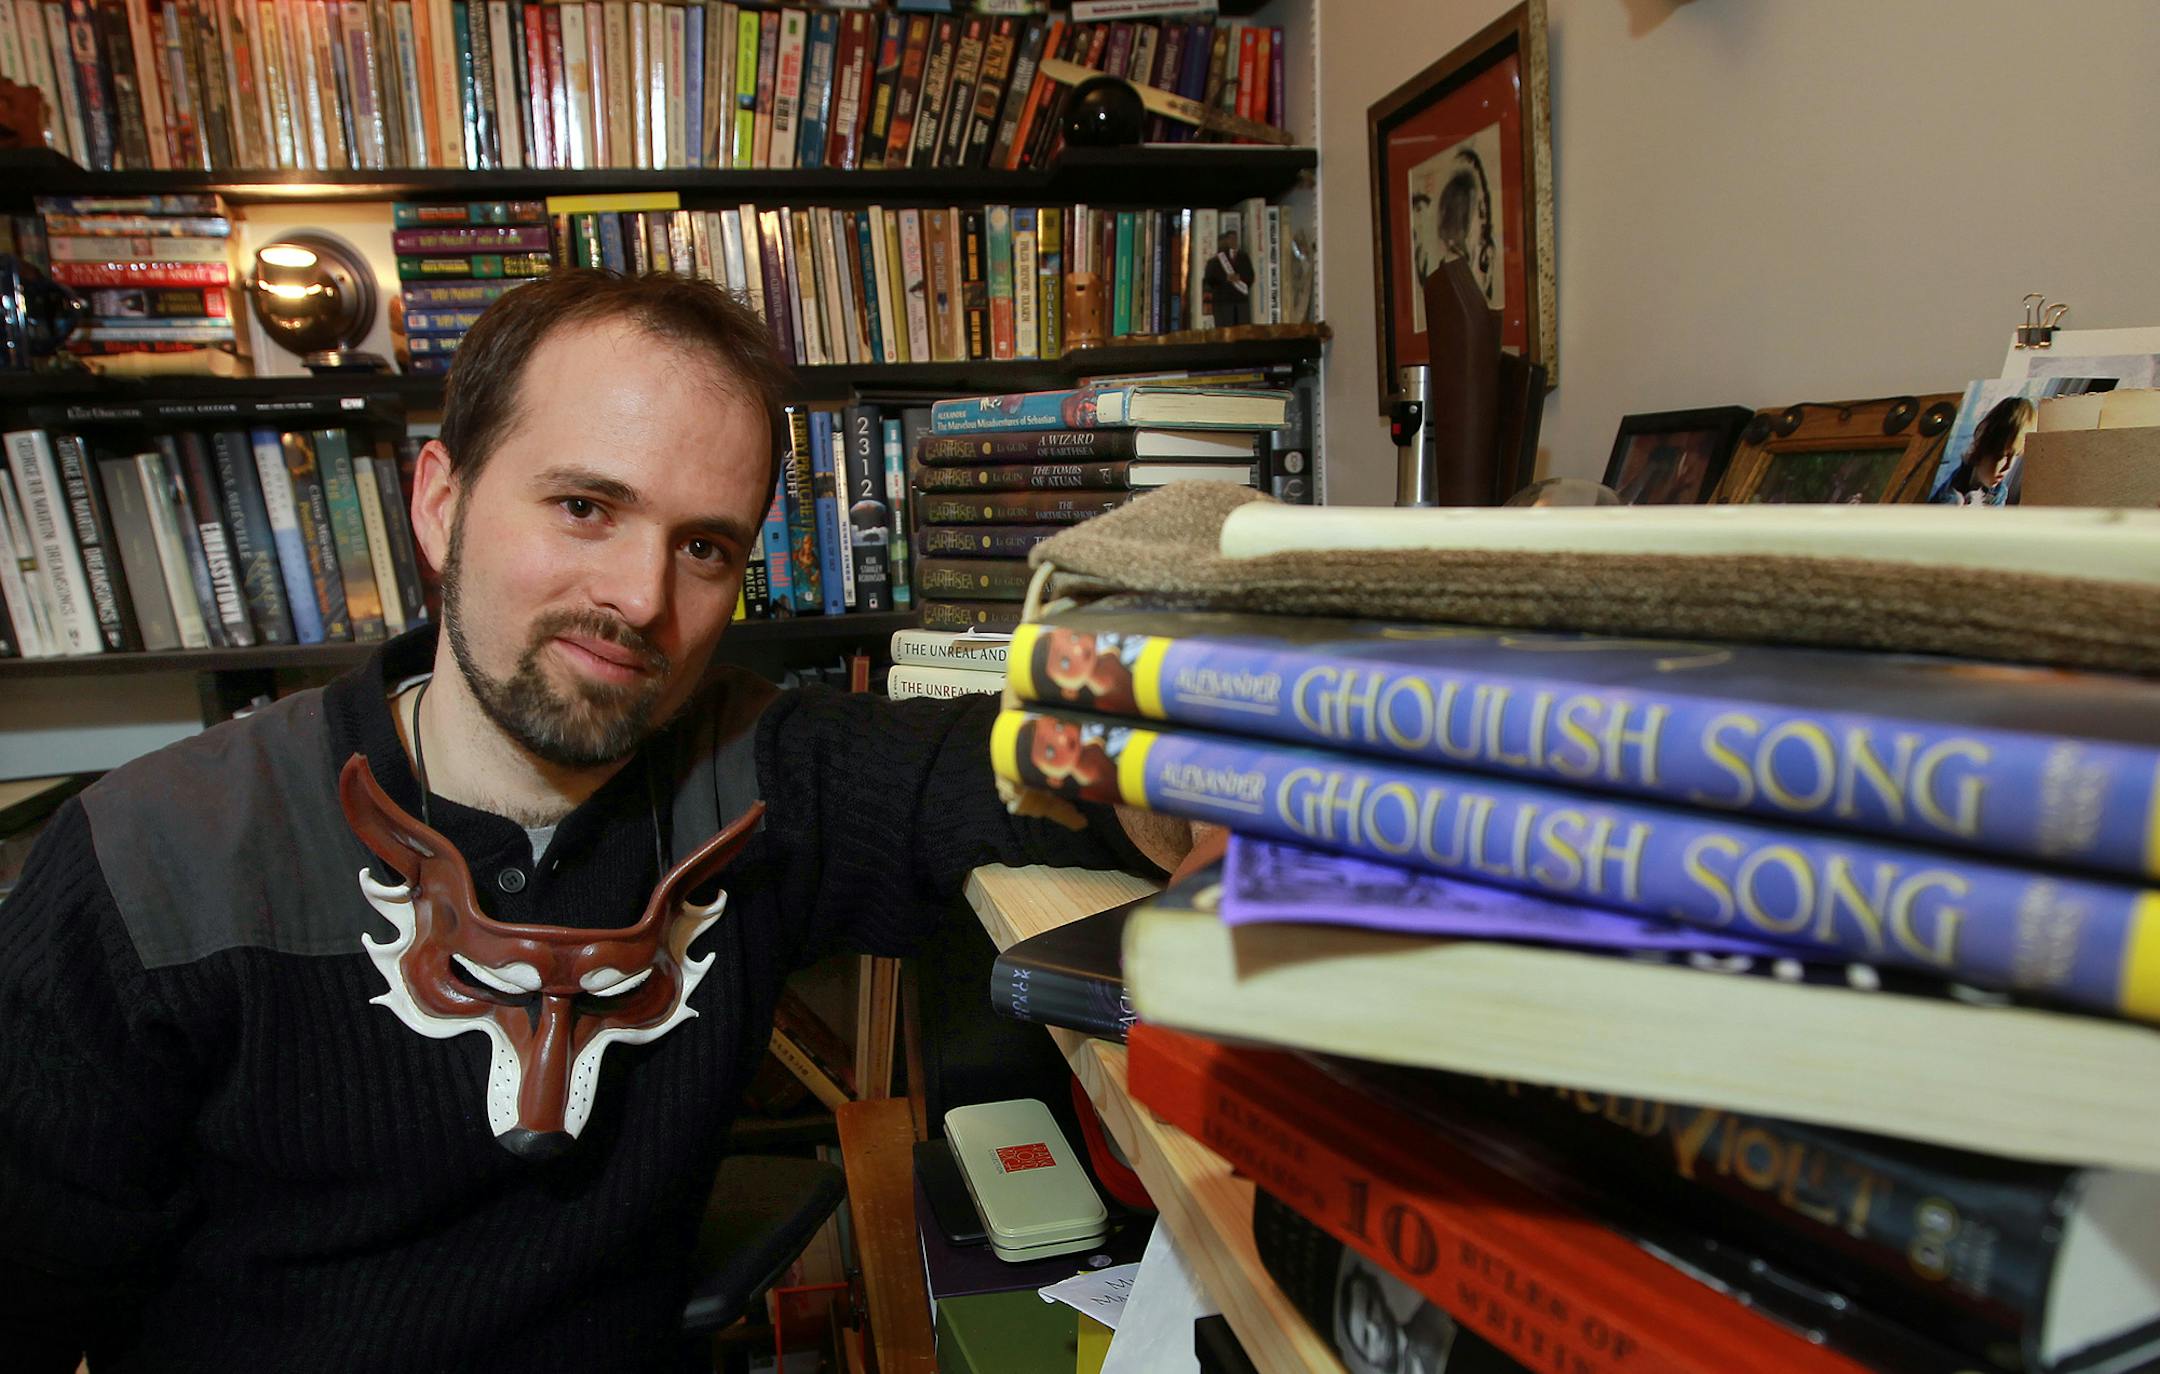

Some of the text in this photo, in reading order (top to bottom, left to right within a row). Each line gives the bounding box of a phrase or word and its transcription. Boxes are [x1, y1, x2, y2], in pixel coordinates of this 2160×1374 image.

[937, 410, 967, 420] ALEXANDER
[937, 415, 1057, 430] The Marvelous Misadventures of Sebastian
[1005, 442, 1028, 452] GUIN
[1038, 433, 1095, 446] A WIZARD
[213, 432, 235, 487] CHINA
[1037, 447, 1095, 457] OF EARTHSEA
[783, 450, 800, 499] SNUFF
[792, 413, 816, 533] TERRY PRATCHETT
[1001, 473, 1024, 482] GUIN
[1032, 465, 1083, 475] THE TOMBS
[1031, 475, 1083, 487] OF ATUAN
[1058, 501, 1074, 510] THE
[1005, 537, 1026, 546] GUIN
[199, 522, 244, 625] EMBASSYTOWN
[859, 564, 883, 574] STANLEY
[755, 566, 768, 599] NIGHT
[858, 572, 886, 583] ROBINSON
[922, 568, 975, 590] EARTHSEA
[1004, 577, 1026, 586] GUIN
[923, 605, 973, 625] EARTHSEA
[904, 642, 1007, 662] THE UNREAL AND
[901, 680, 923, 695] THE
[1173, 666, 1282, 704] ALEXANDER
[1292, 665, 1672, 788] GHOULISH
[1700, 711, 1995, 840] SONG
[1159, 762, 1267, 803] ALEXANDER
[1276, 767, 1653, 903] GHOULISH
[1682, 833, 1975, 970] SONG
[1337, 1174, 1441, 1277] 10
[1459, 1240, 1638, 1361] RULES OF
